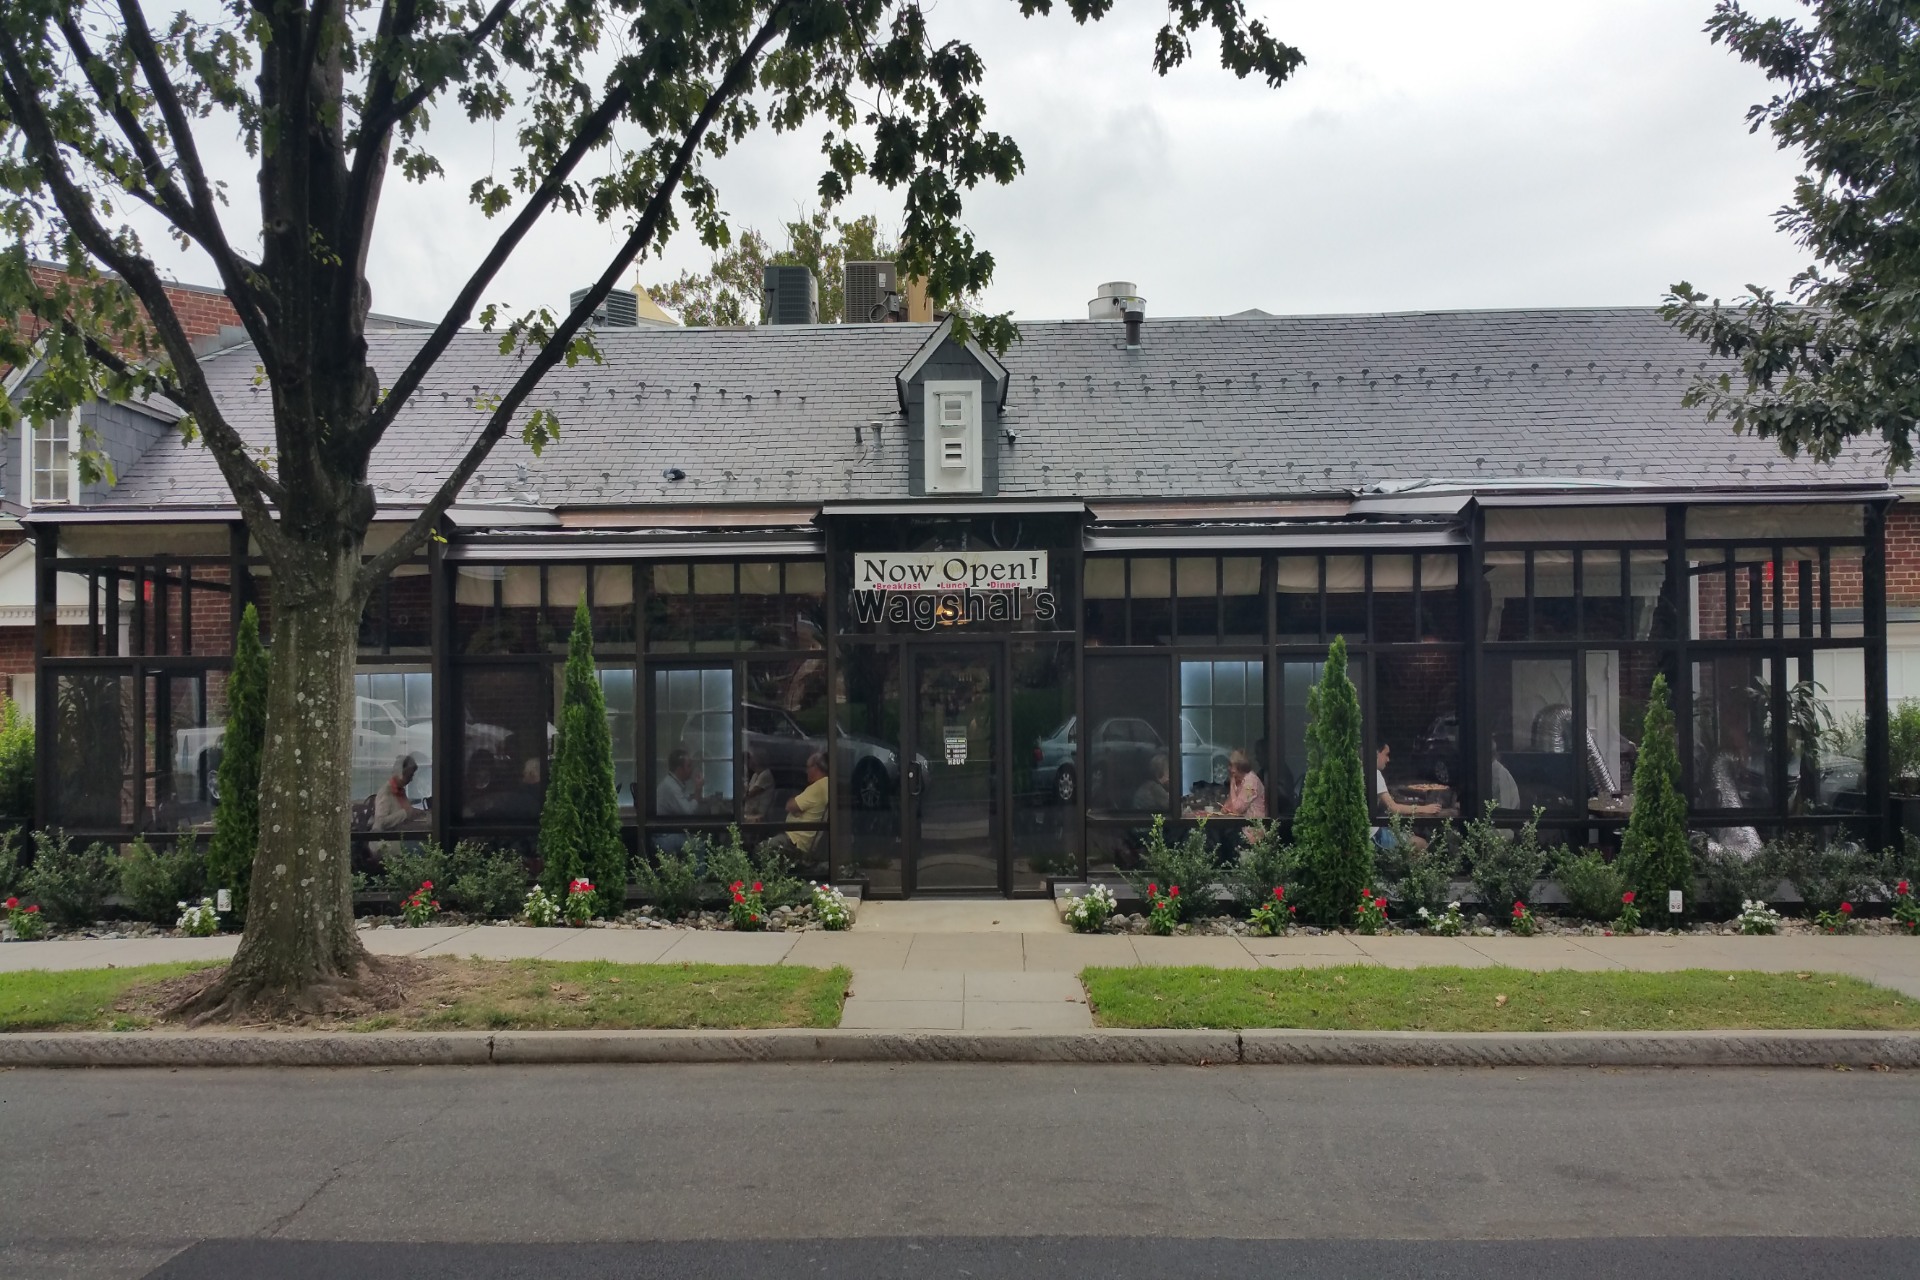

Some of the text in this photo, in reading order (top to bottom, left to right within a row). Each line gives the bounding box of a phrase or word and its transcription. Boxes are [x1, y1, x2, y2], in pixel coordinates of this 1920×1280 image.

[863, 560, 934, 582] Now
[943, 557, 1040, 587] Open!
[876, 582, 921, 590] Breakfast
[940, 581, 968, 589] Lunch
[853, 586, 1056, 630] Wagshal's
